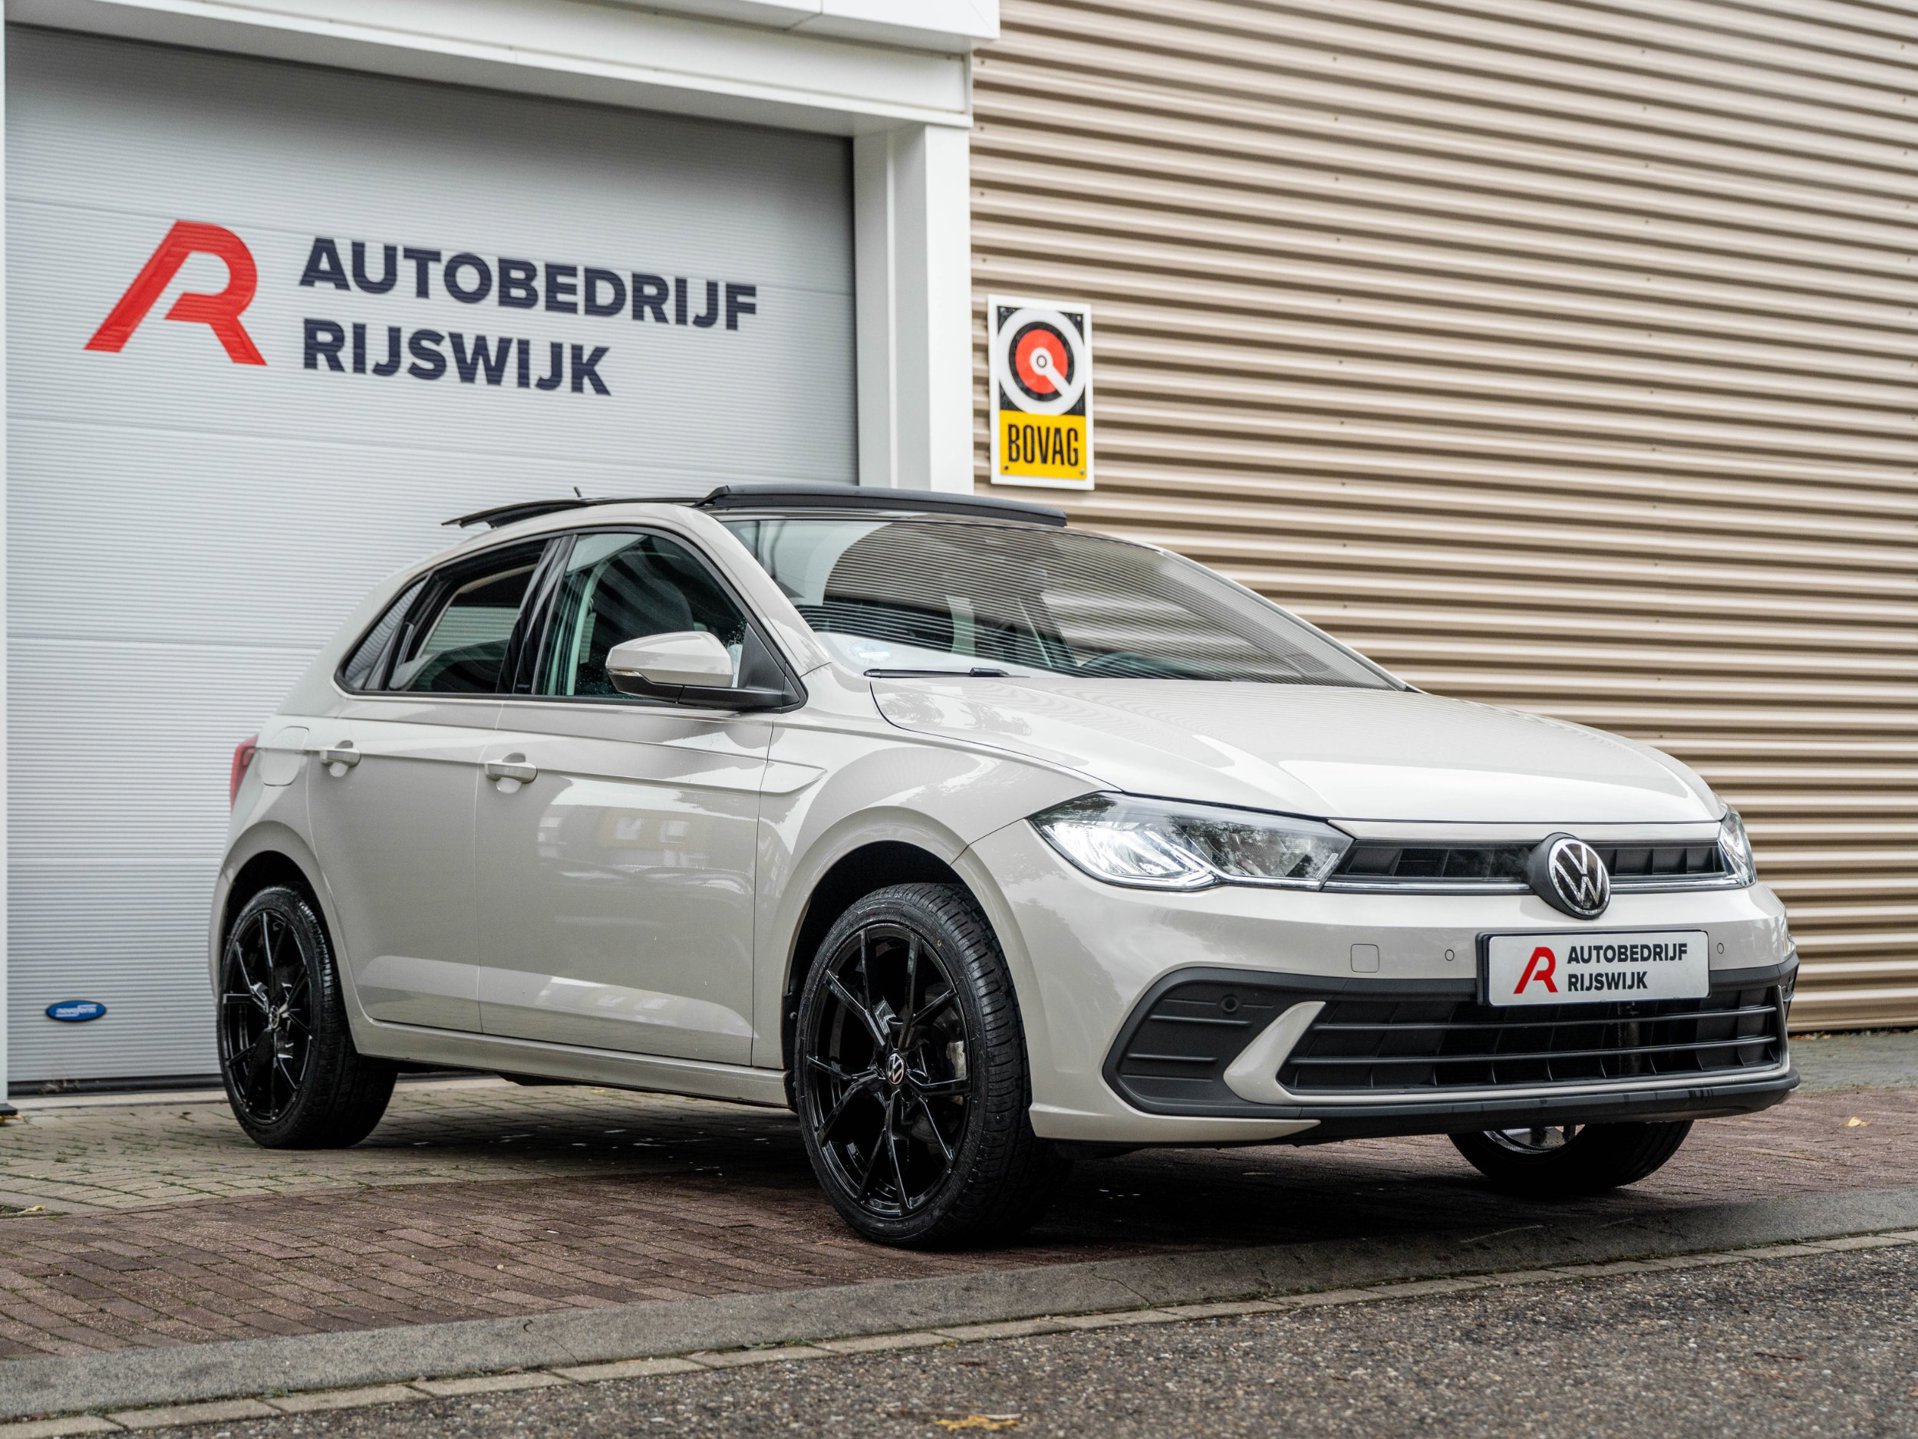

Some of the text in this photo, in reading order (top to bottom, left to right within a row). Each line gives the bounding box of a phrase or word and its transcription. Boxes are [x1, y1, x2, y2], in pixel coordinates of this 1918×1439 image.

[299, 237, 757, 331] AUTOBEDRIJF
[303, 318, 611, 396] RIJSWIJK
[1007, 423, 1079, 467] BOVAG
[1567, 943, 1688, 964] AUTOBEDRIJF
[1567, 971, 1648, 993] RIJSWIJK
